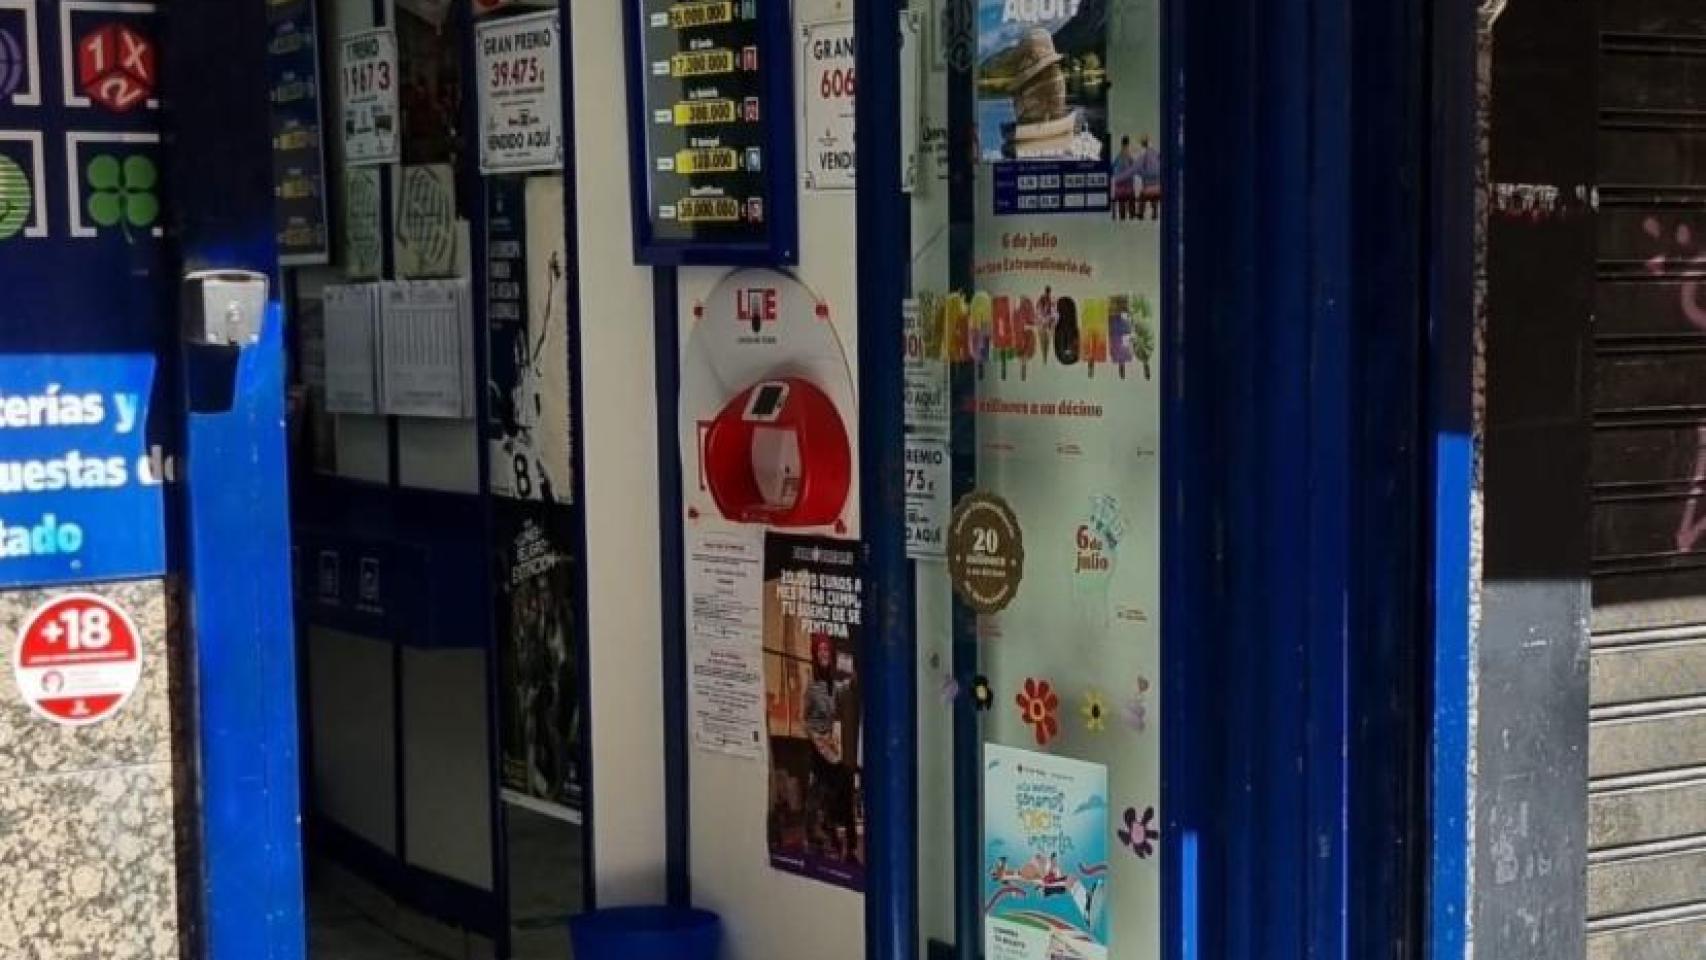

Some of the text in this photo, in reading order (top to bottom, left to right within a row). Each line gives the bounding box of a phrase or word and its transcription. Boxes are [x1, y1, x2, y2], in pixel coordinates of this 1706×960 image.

[484, 28, 551, 57] GRAN PREMIO
[814, 38, 855, 60] GRAN
[491, 57, 539, 88] 39.475
[1028, 232, 1058, 251] julio
[0, 382, 138, 434] erías y
[972, 527, 998, 553] 20
[1077, 524, 1089, 551] 6
[1075, 551, 1109, 574] julio
[41, 607, 112, 651] +18
